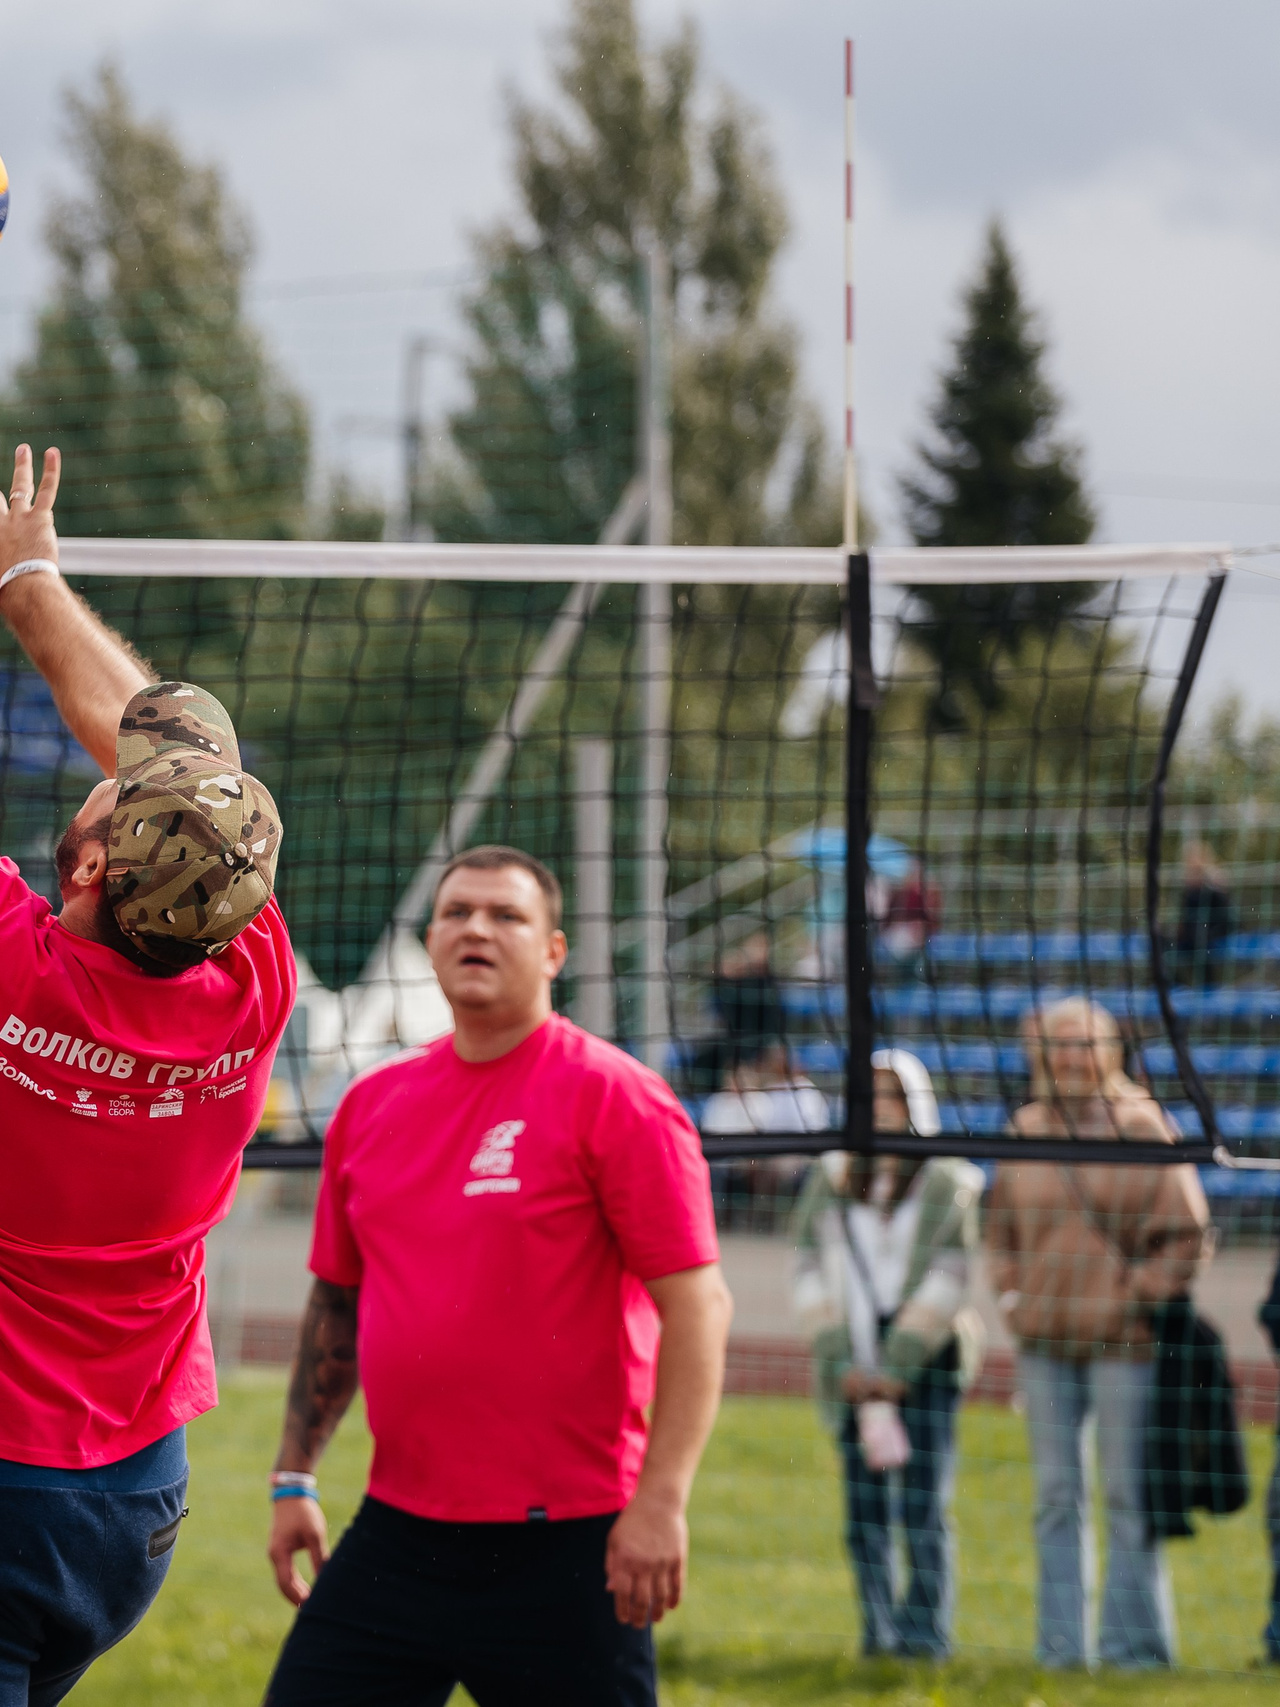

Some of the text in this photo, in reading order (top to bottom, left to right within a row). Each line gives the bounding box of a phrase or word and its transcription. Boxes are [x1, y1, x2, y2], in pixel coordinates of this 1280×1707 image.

[147, 1048, 255, 1085] ГРУПП
[109, 1100, 136, 1108] ТОЧКА
[108, 1108, 135, 1116] СБОРА
